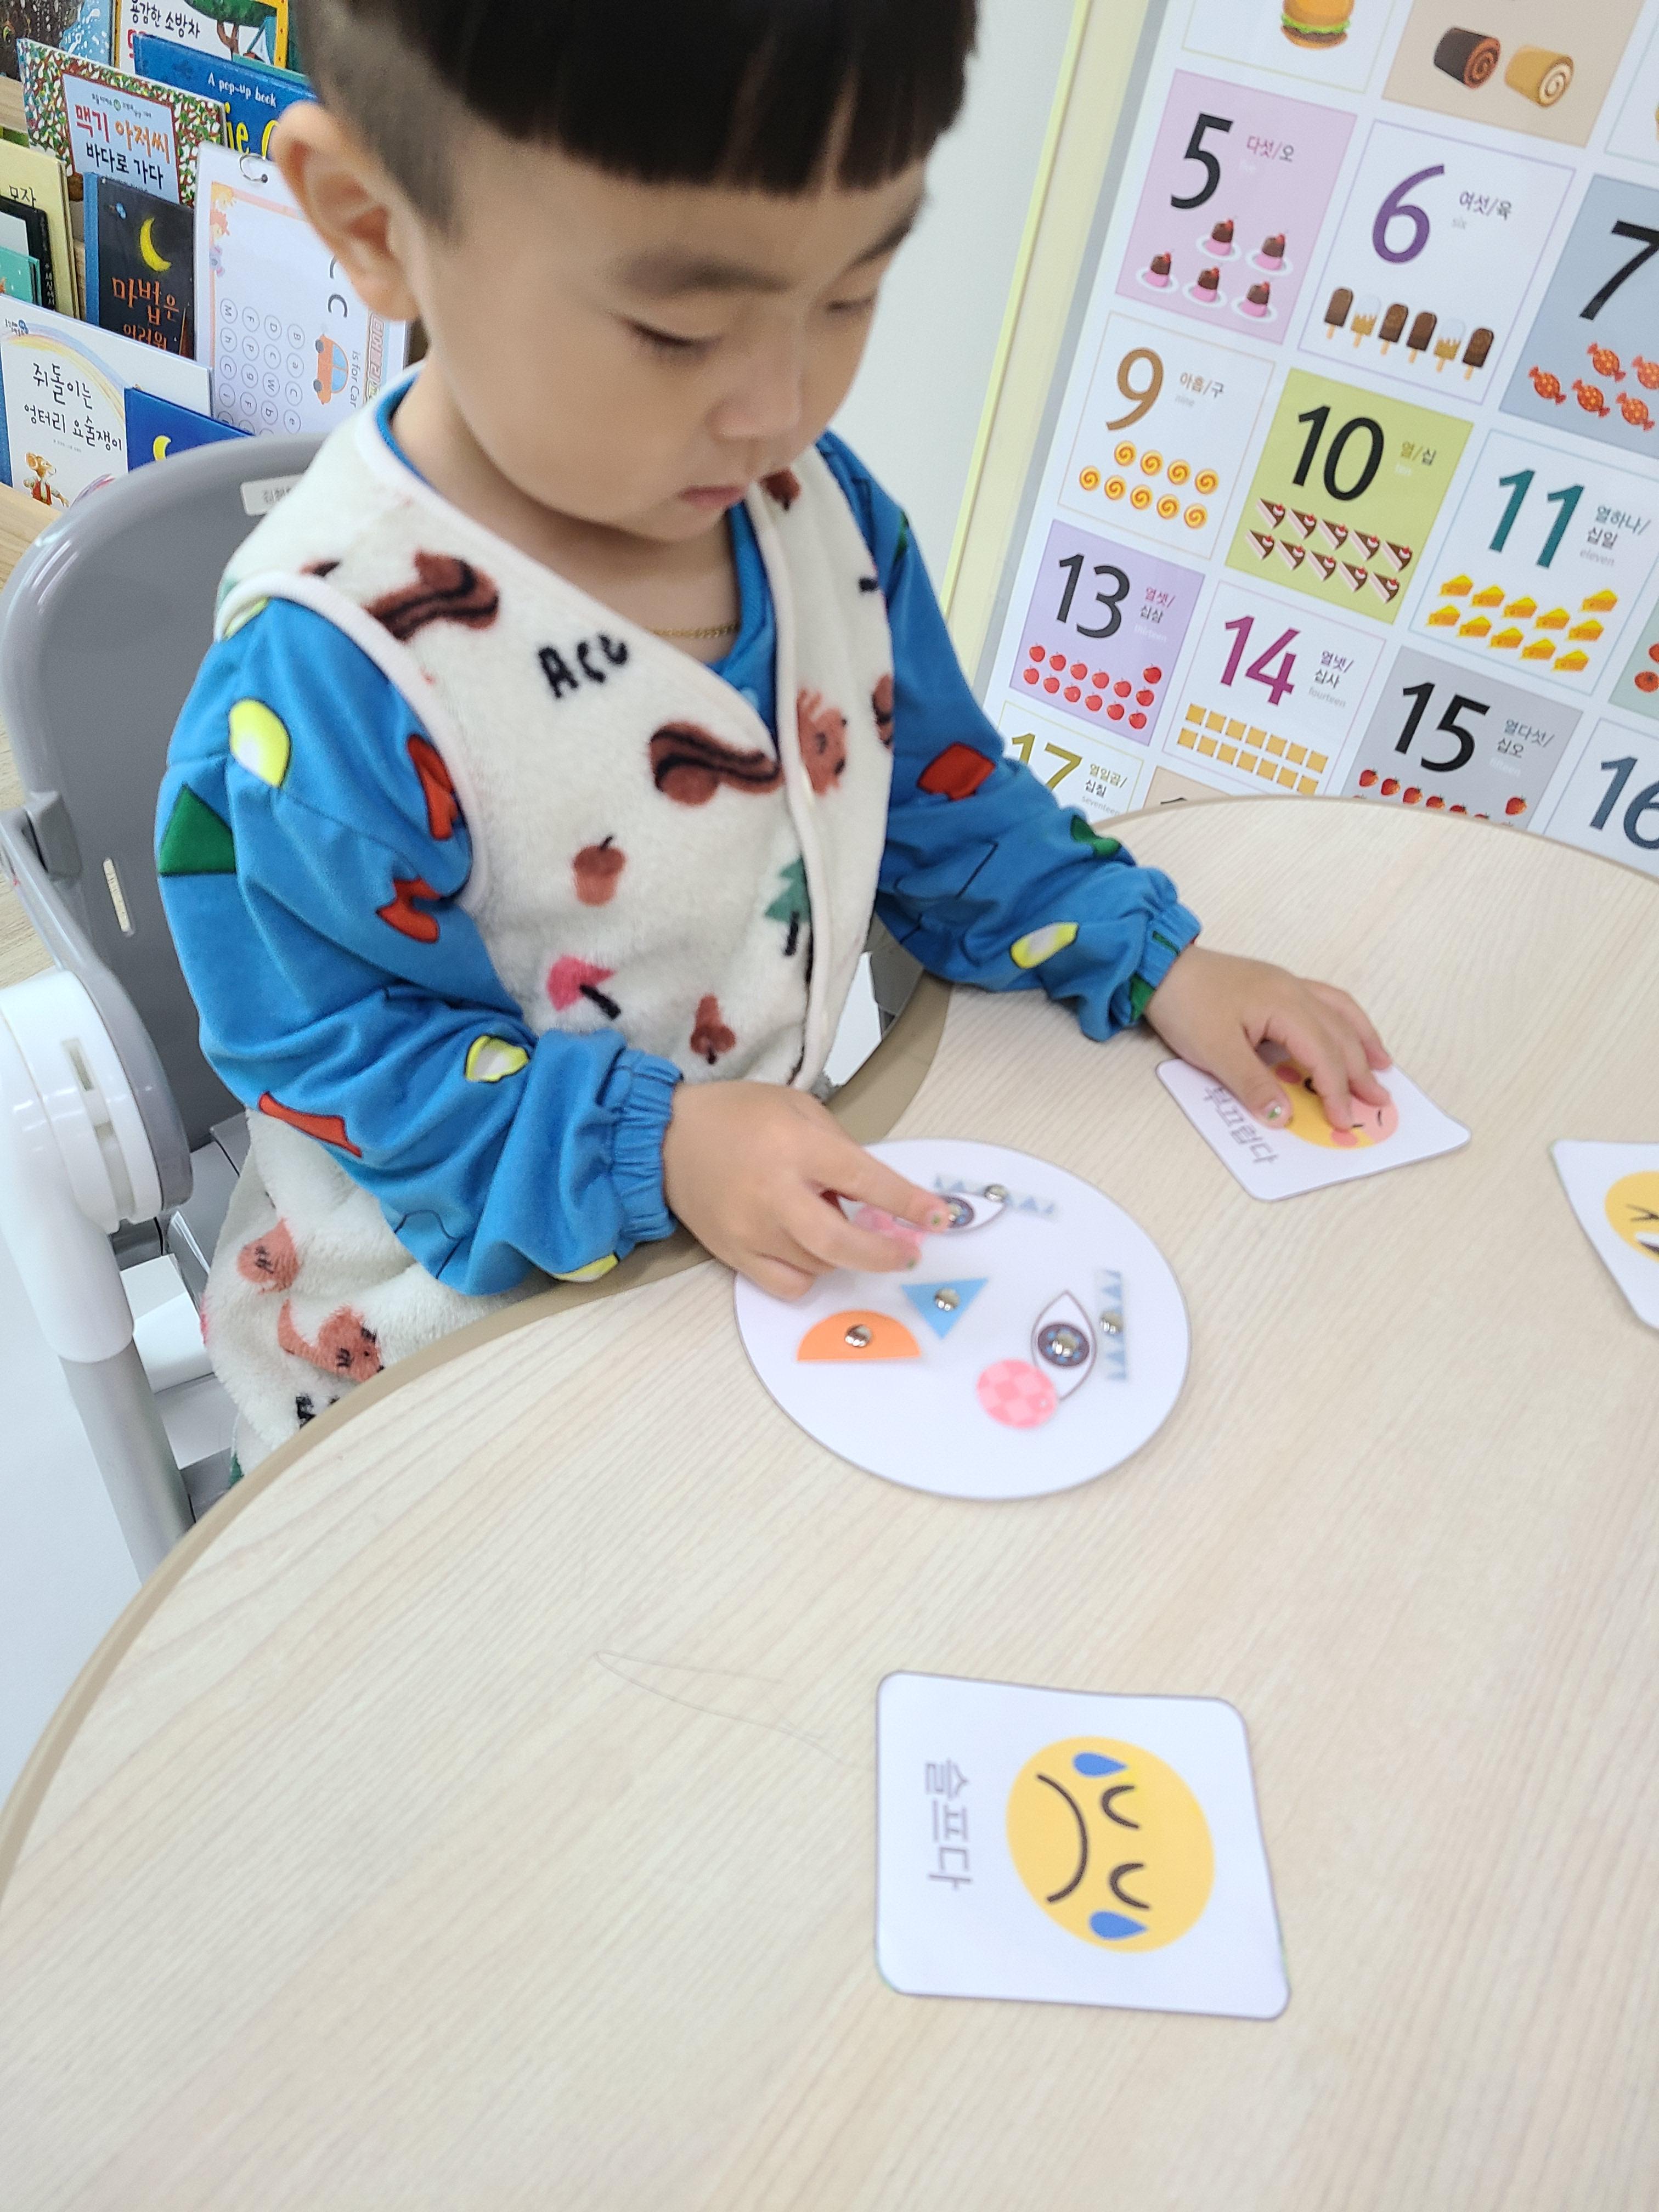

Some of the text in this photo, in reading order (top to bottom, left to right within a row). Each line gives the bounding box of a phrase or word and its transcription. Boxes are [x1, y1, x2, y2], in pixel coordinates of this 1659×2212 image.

[130, 0, 200, 38] 용감한 소방차
[208, 72, 276, 108] A pop-up book
[75, 105, 110, 143] 맥기
[115, 120, 170, 164] 아저씨
[1246, 136, 1294, 162] 다섯/오
[86, 143, 163, 190] 바다로 가다
[1171, 111, 1234, 210] 5
[10, 185, 37, 210] 모자
[1373, 165, 1444, 264] 6
[1579, 221, 1659, 320] 7
[112, 277, 179, 326] 마법은
[33, 363, 93, 410] 쥐돌이는
[350, 351, 361, 408] is for Car
[1106, 348, 1164, 431] 9
[24, 404, 66, 433] 엉터리
[72, 415, 122, 451] 요술쟁이
[1293, 406, 1384, 501] 10
[1489, 469, 1585, 568] 11
[1587, 527, 1618, 549] 십일
[1596, 505, 1651, 535] 열하나/
[1057, 554, 1130, 639] 13
[1221, 616, 1301, 706] 14
[1314, 669, 1340, 689] 십사
[1308, 687, 1346, 708] fourteen
[1395, 682, 1491, 772] 15
[1497, 737, 1525, 758] 십오
[1504, 719, 1555, 748] 열다섯/
[1011, 733, 1082, 791] 17
[1090, 763, 1128, 788] 열일곱/
[1084, 779, 1107, 798] 십칠
[1590, 756, 1659, 850] 16
[924, 1757, 972, 1891] 슬프다
